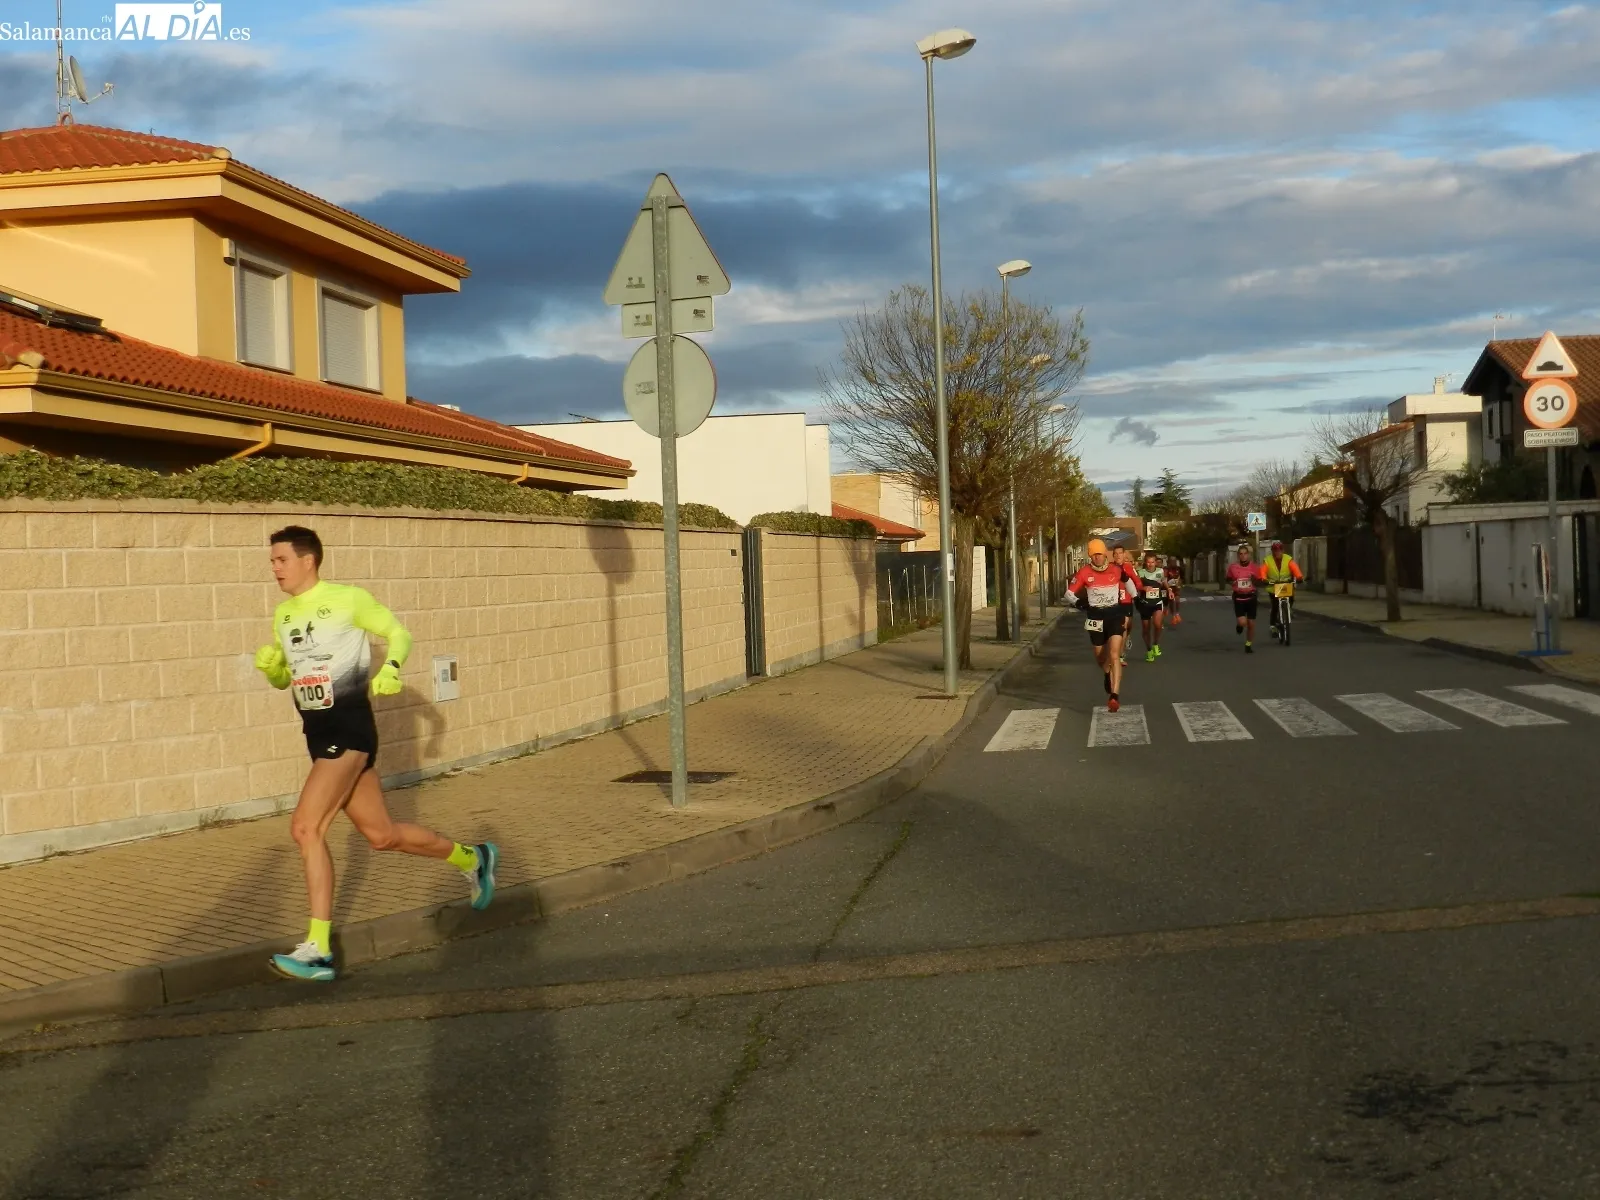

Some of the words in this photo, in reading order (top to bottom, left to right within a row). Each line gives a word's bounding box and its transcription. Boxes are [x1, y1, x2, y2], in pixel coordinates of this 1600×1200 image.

[1536, 395, 1565, 412] 30
[1088, 620, 1098, 628] 48
[300, 684, 325, 702] 100
